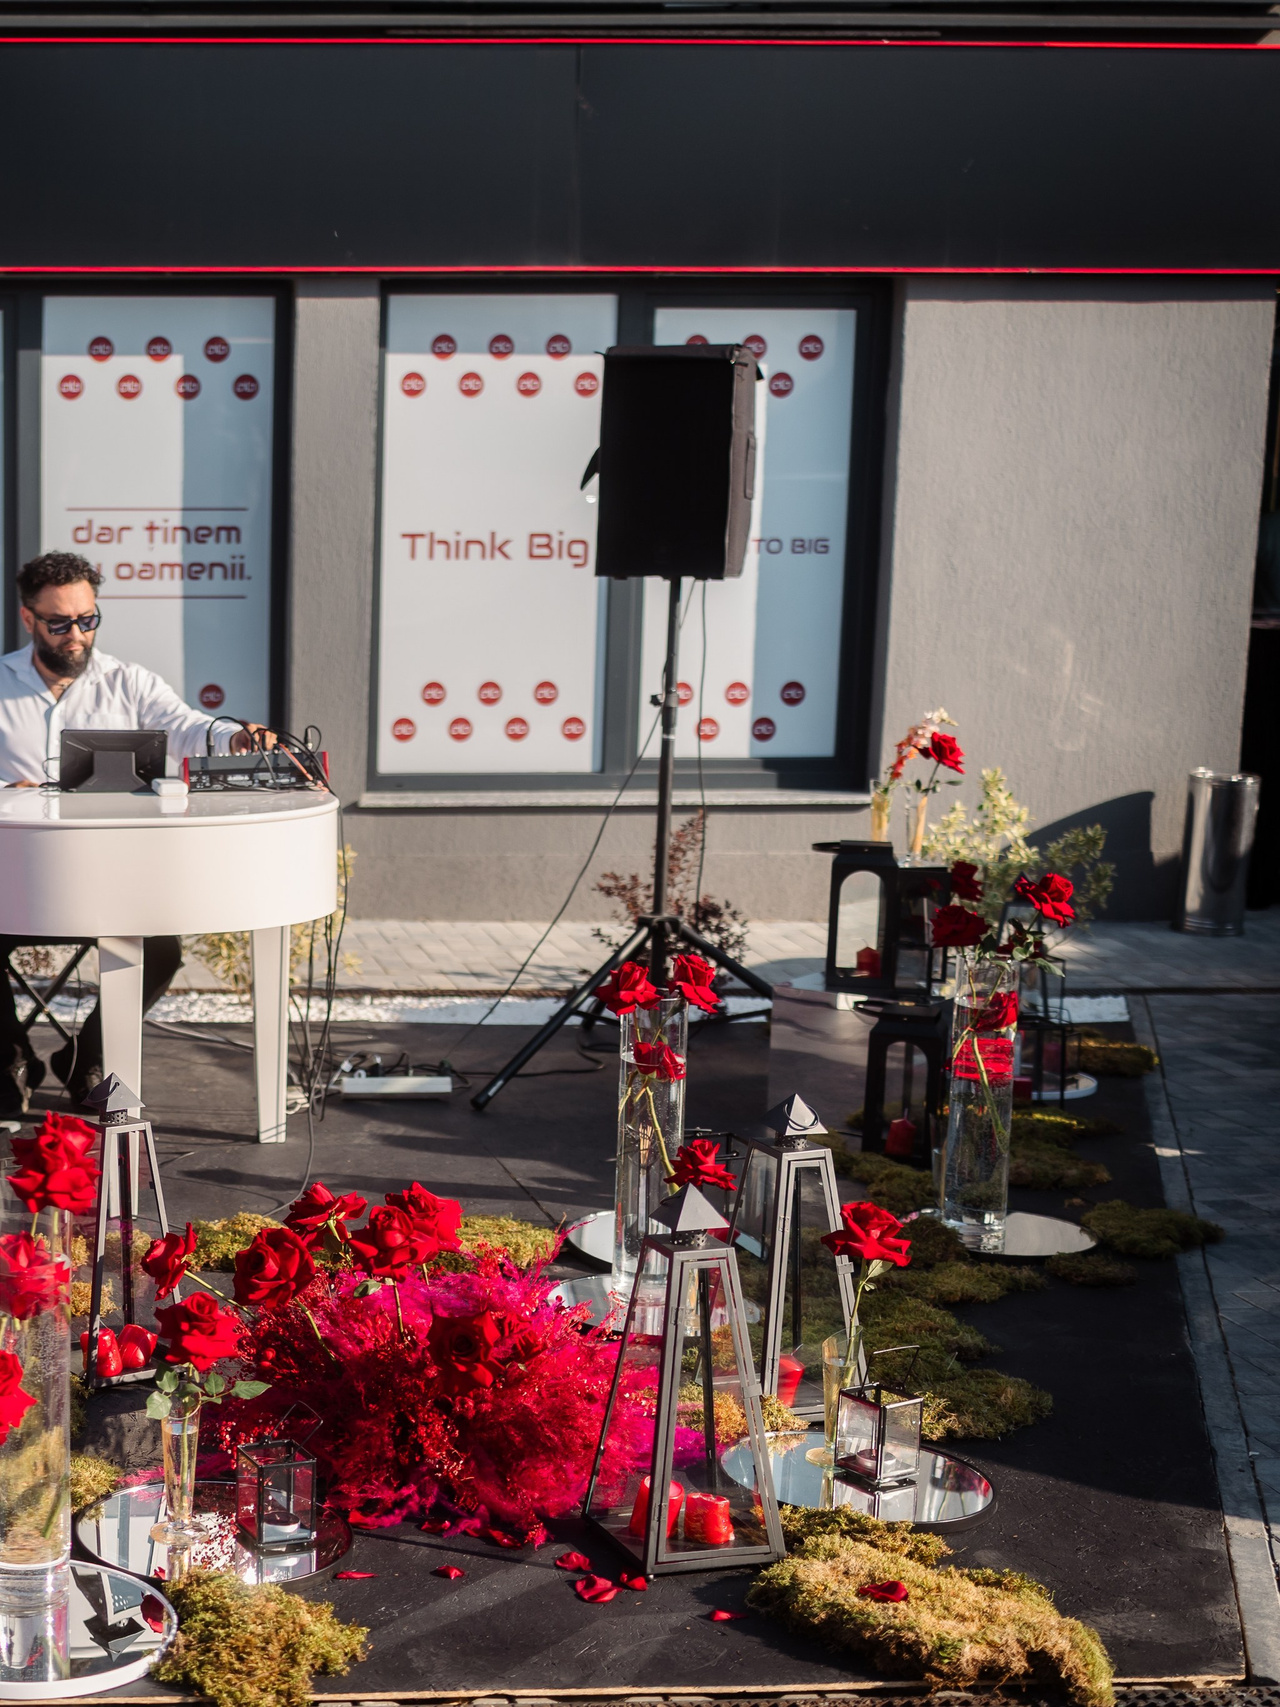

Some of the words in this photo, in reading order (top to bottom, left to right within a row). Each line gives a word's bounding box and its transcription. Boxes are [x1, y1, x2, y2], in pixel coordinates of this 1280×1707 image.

[72, 518, 133, 545] dar
[400, 531, 513, 561] Think
[527, 531, 590, 568] Big
[751, 538, 783, 554] TO
[790, 538, 831, 554] BIG
[114, 555, 252, 581] oamenii.
